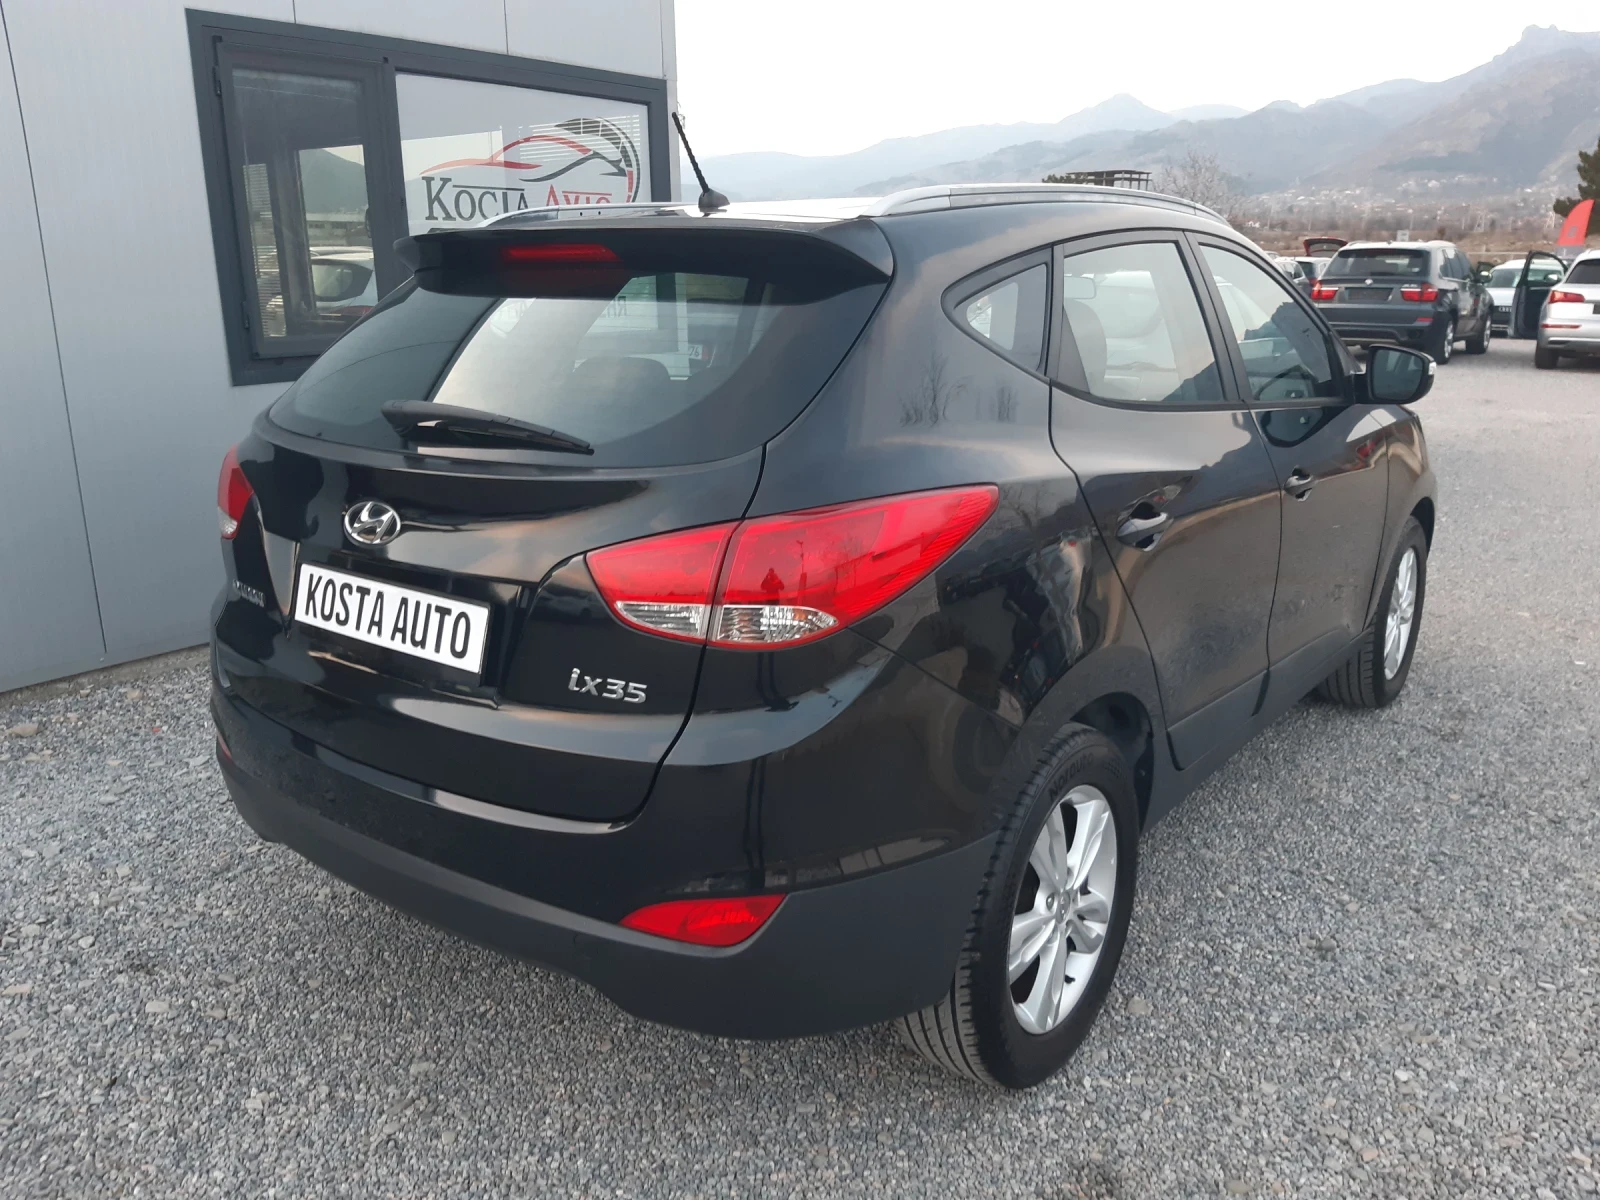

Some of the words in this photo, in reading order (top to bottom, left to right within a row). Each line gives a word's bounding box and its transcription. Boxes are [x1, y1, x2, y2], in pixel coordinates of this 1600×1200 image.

[305, 573, 385, 638] KOSTA
[390, 596, 471, 659] AUTO
[568, 667, 647, 703] ix35
